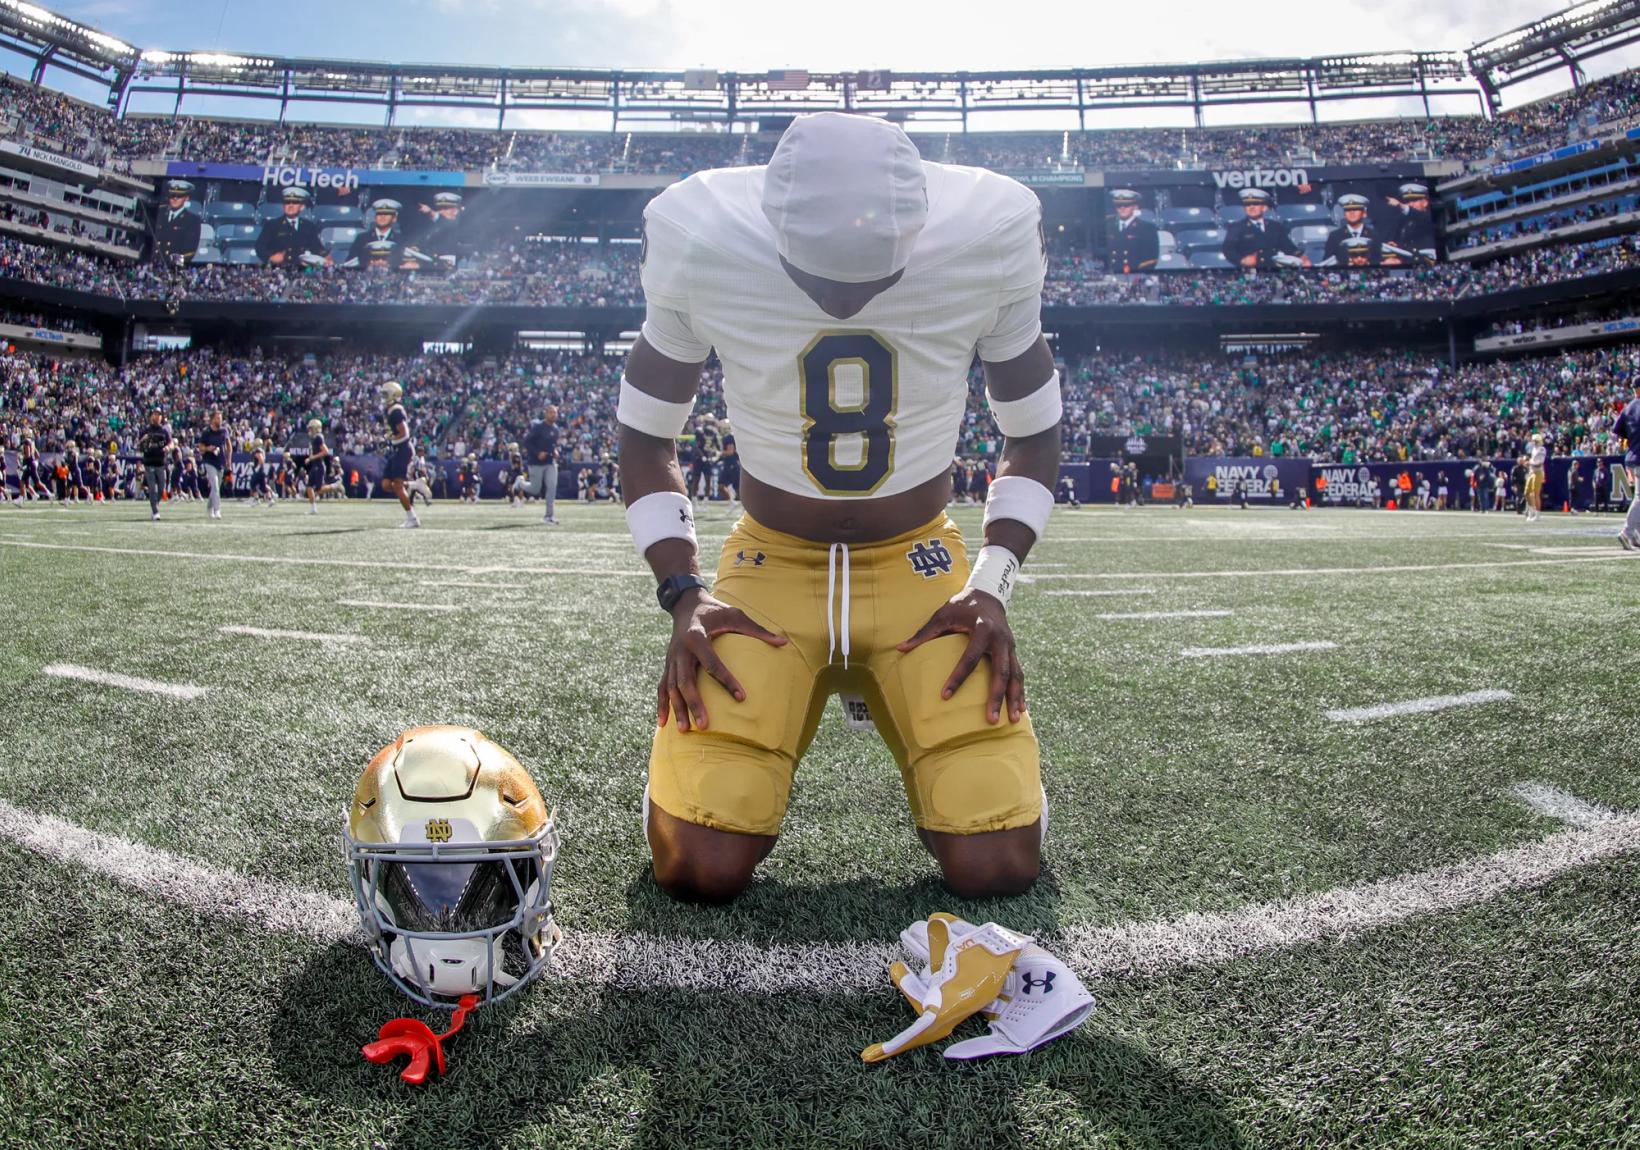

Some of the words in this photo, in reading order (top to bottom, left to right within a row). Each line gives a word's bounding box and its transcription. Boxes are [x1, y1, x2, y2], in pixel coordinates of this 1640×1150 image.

[19, 145, 31, 156] 74
[33, 151, 48, 160] NICK
[49, 154, 82, 170] MANGOLD
[262, 167, 359, 189] HCLTech
[1212, 165, 1308, 188] verizon
[1513, 335, 1536, 344] verizon
[797, 328, 898, 497] 8
[1216, 466, 1260, 479] NAVY
[1322, 469, 1356, 482] NAVY
